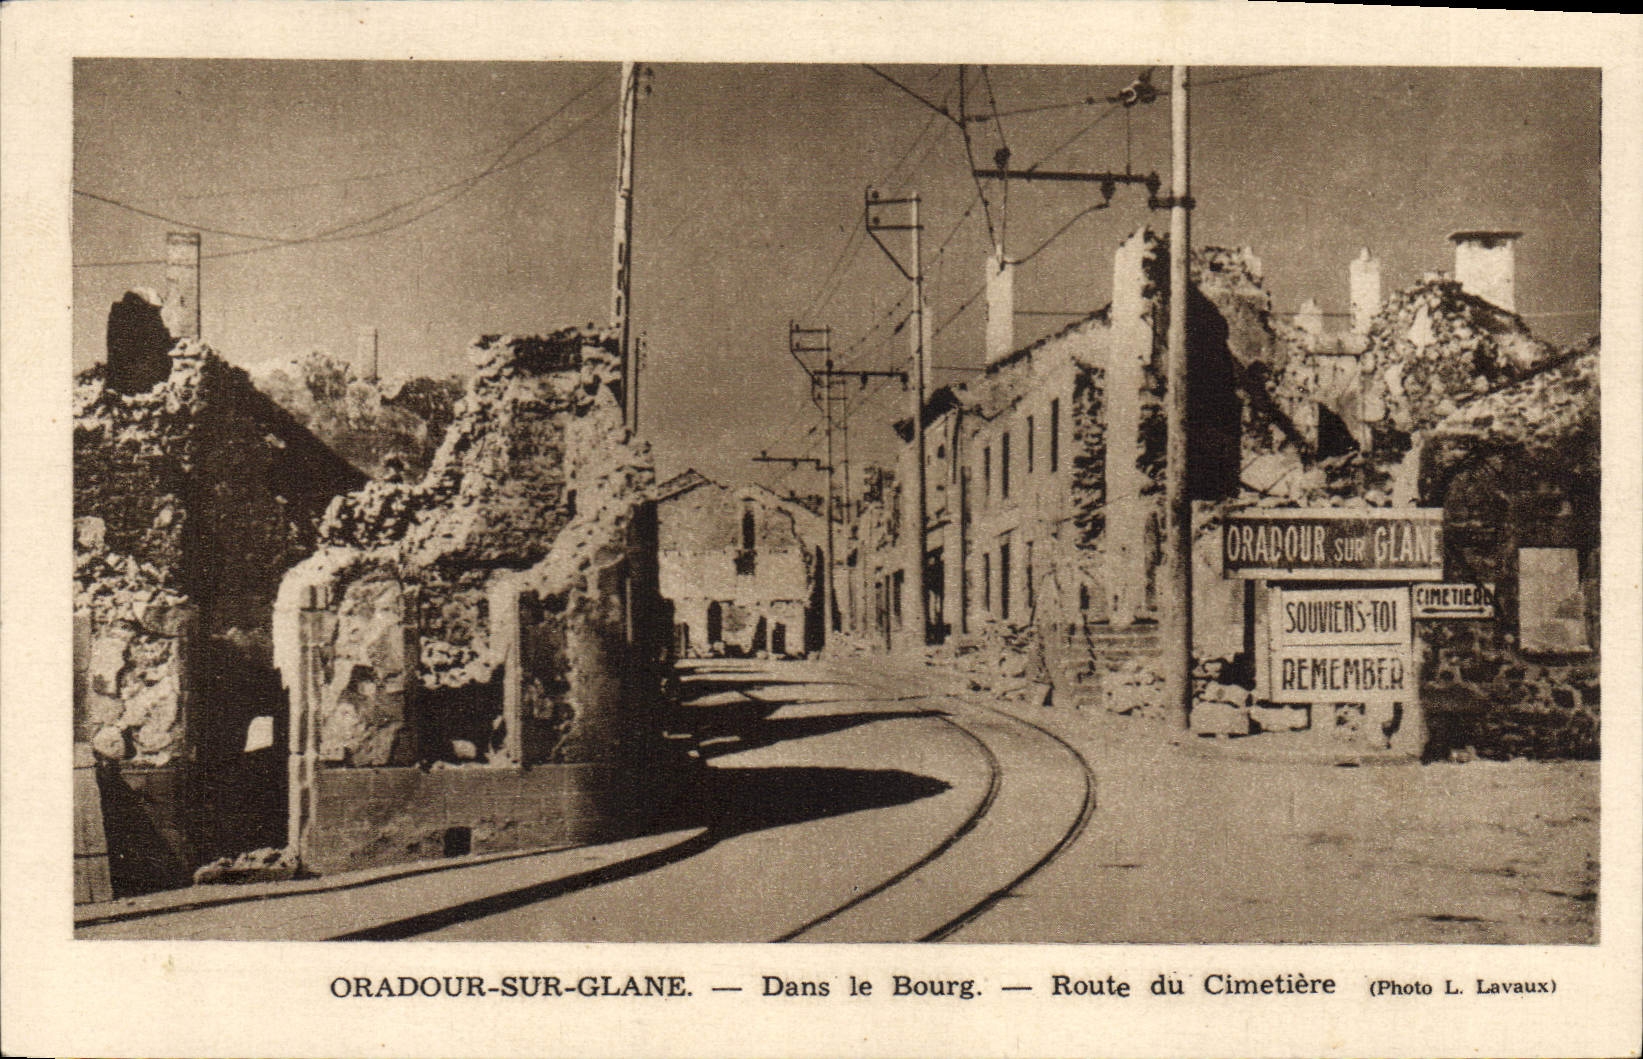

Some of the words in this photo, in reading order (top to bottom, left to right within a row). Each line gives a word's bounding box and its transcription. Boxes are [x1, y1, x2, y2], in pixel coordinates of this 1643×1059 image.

[1227, 525, 1325, 562] ORADOUR
[1334, 537, 1365, 562] SUR
[1374, 525, 1443, 563] GLANE
[1285, 600, 1397, 634] SOUVIENS-TOI
[1282, 657, 1404, 691] REMEMBER
